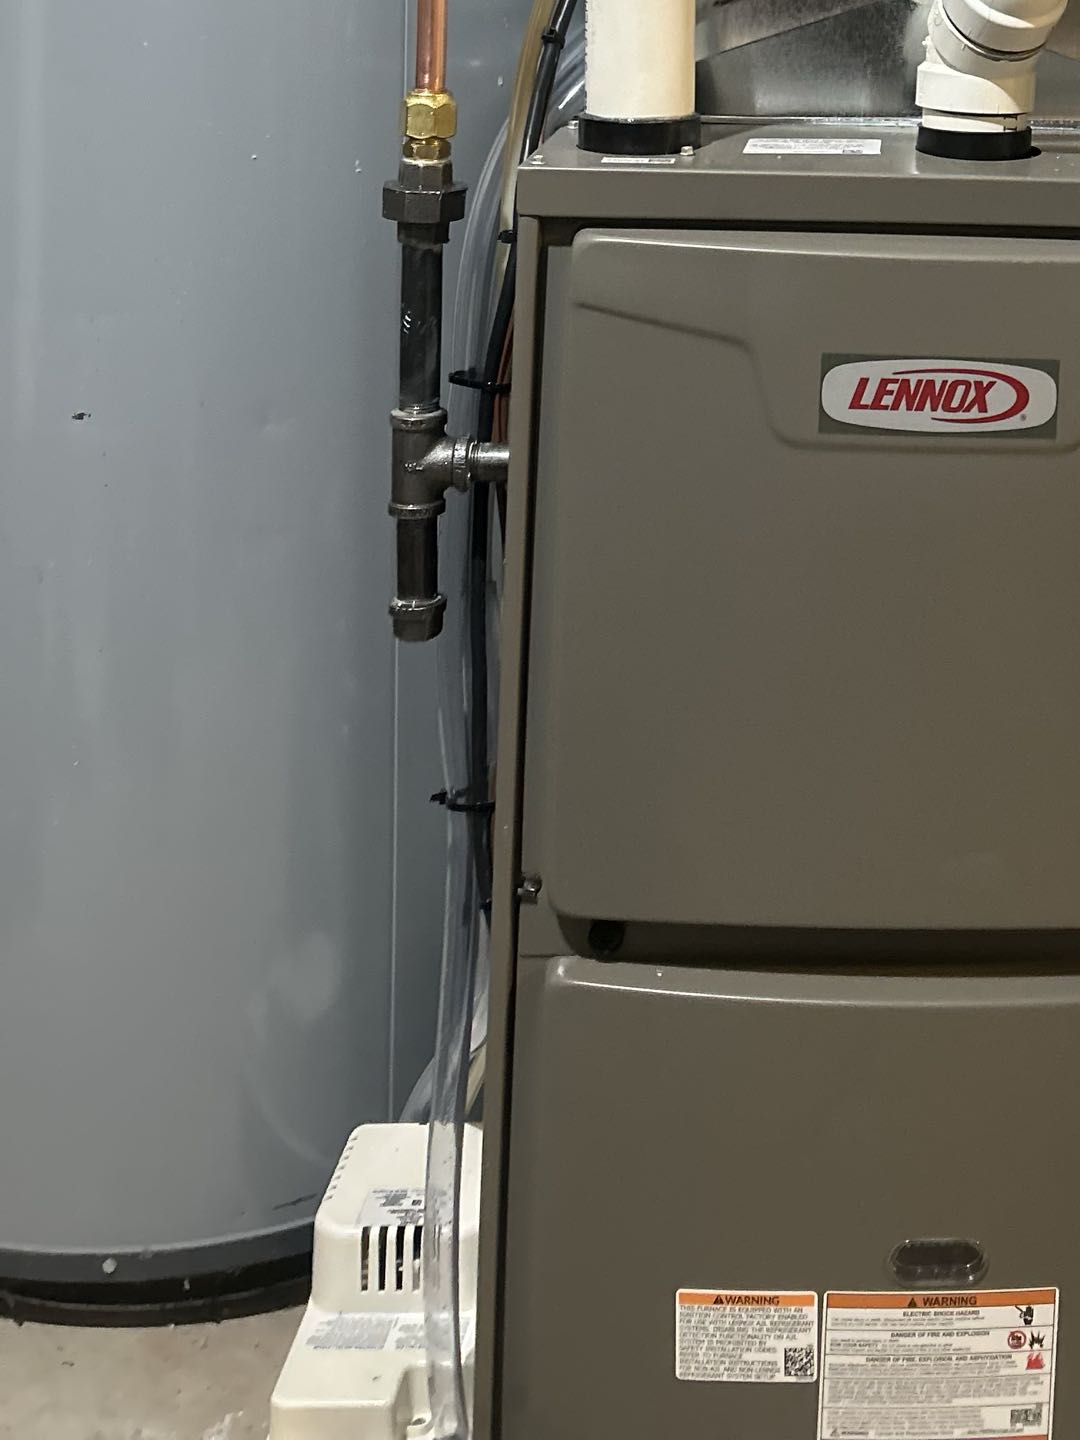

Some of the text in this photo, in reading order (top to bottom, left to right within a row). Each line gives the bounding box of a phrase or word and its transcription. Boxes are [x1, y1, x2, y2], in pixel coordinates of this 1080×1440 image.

[848, 377, 997, 414] LENNOX
[724, 1296, 780, 1306] WARNING
[922, 1296, 978, 1307] WARNING
